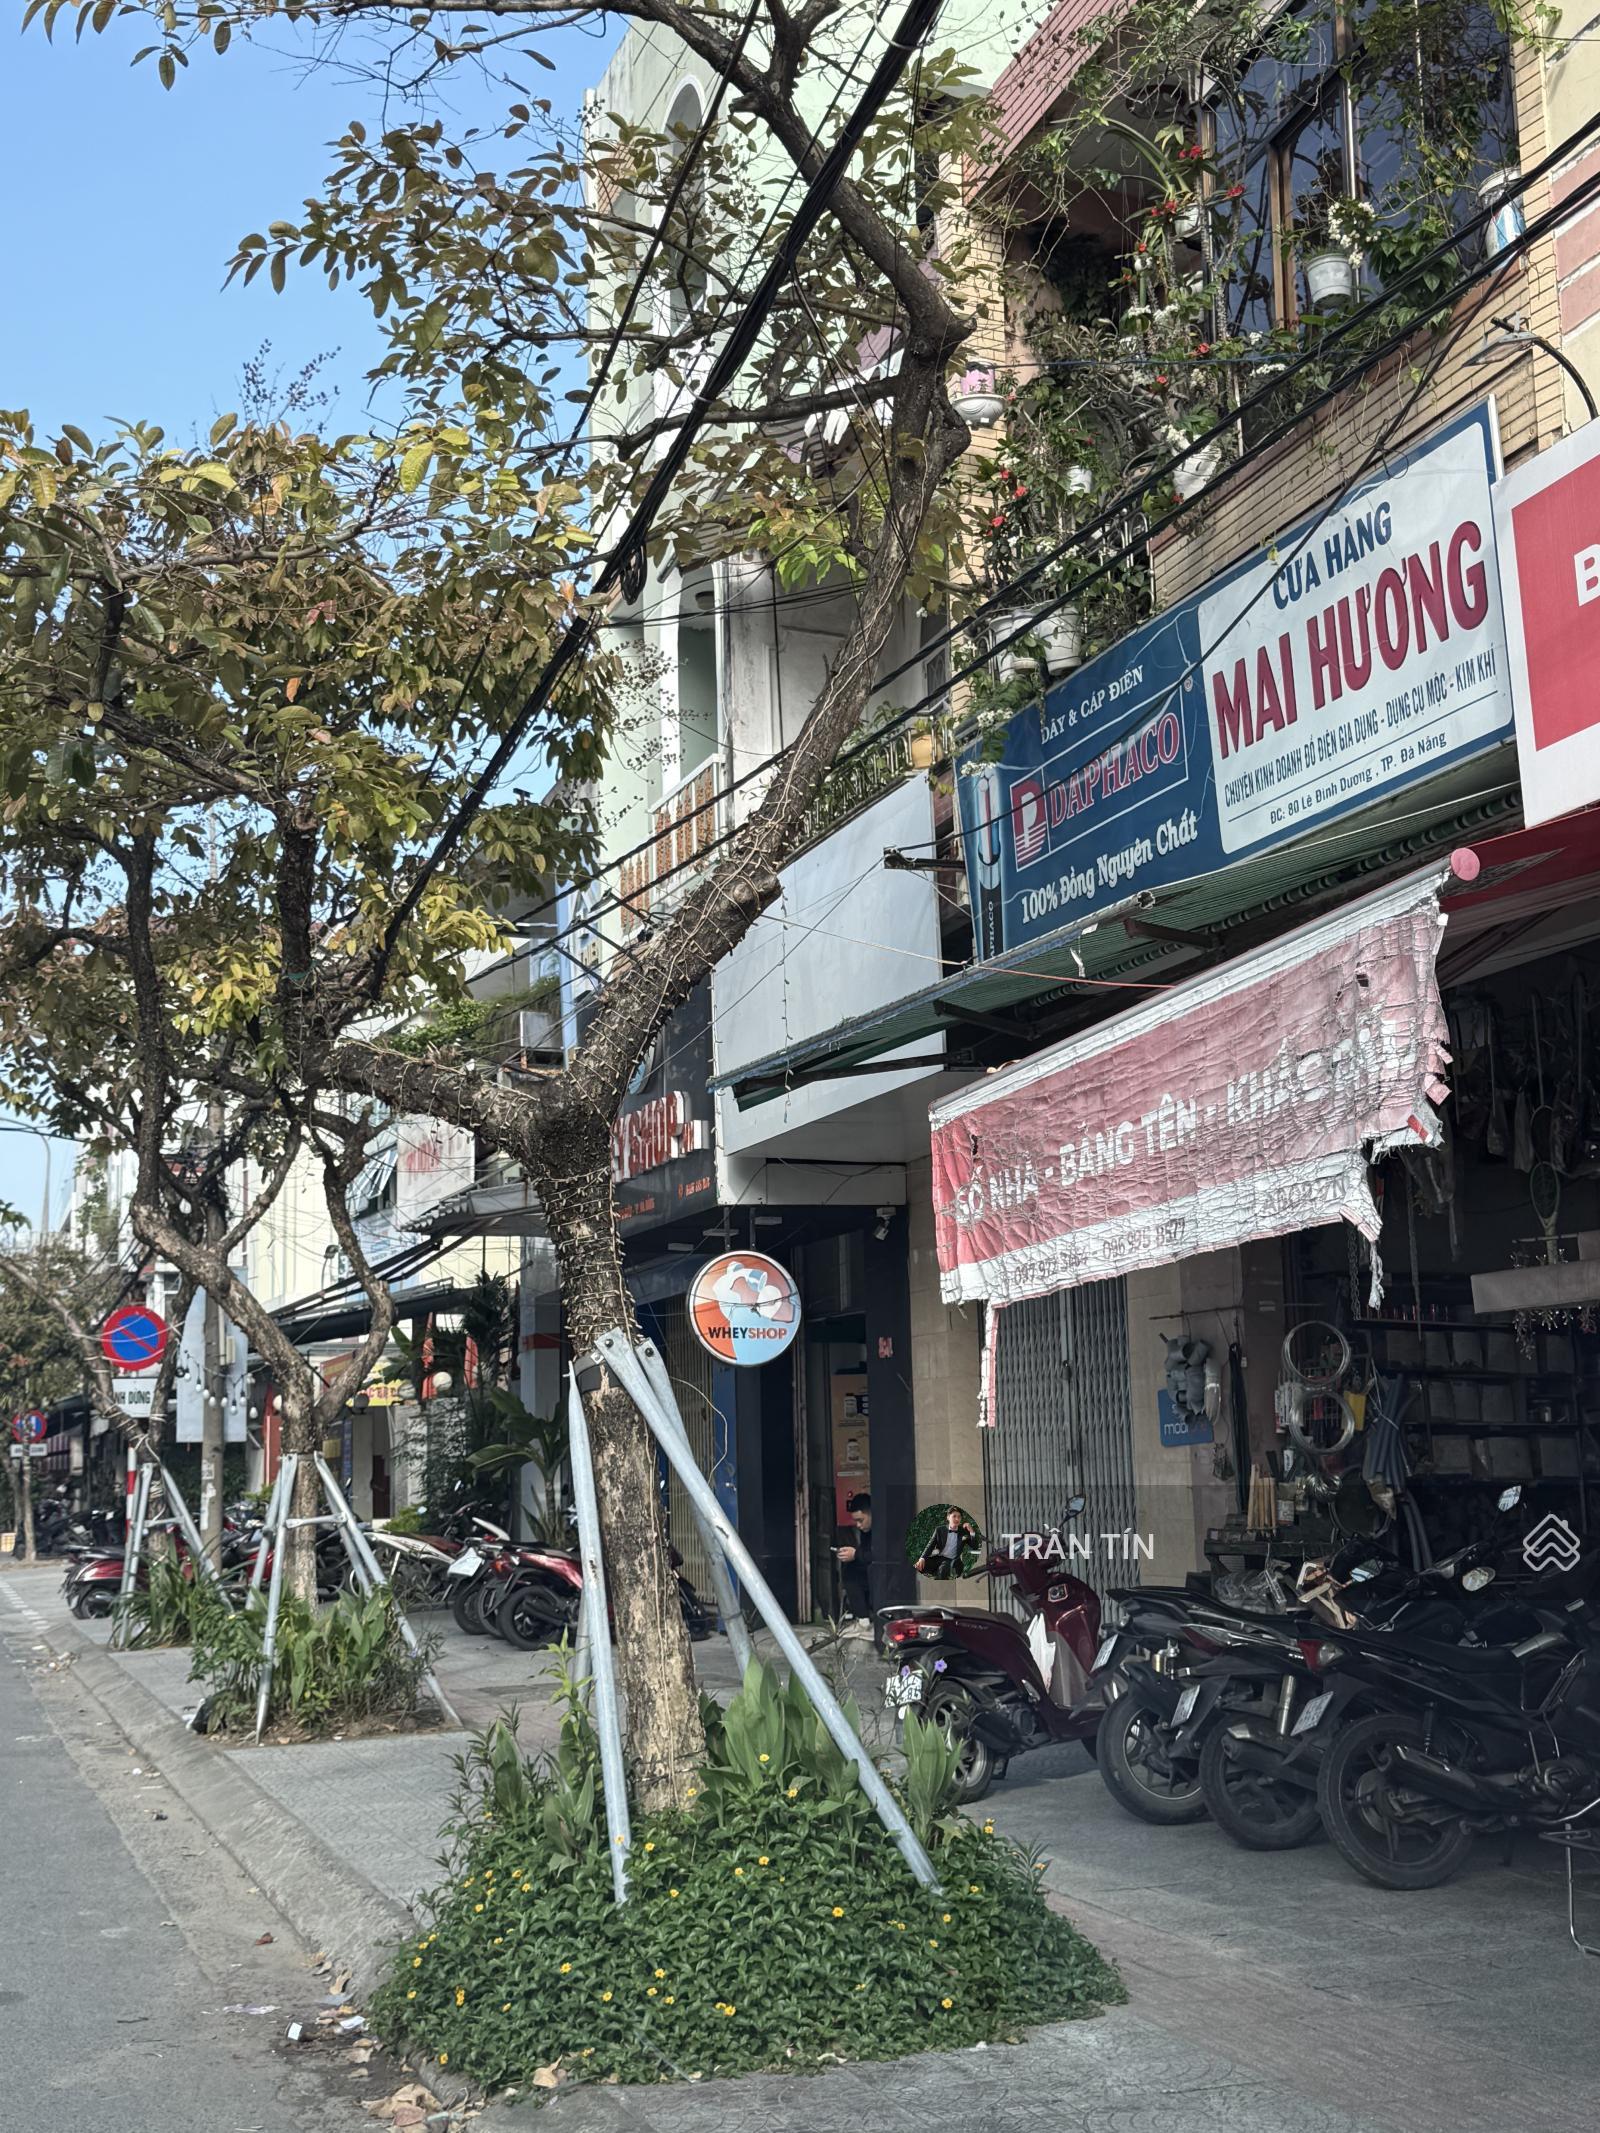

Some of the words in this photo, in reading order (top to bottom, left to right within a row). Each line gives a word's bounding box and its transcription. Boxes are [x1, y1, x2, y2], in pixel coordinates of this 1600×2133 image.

[1323, 501, 1392, 579] HÀNG
[1212, 631, 1298, 760] MAI
[1306, 520, 1489, 711] HƯƠNG
[1040, 714, 1066, 745] DÂY
[1068, 708, 1078, 727] &
[1108, 664, 1144, 702] ĐIỆN
[1224, 770, 1255, 807] CHUYÊN
[1255, 761, 1275, 792] KINH
[1276, 747, 1303, 783] DOANH
[1338, 721, 1354, 752] GIA
[1354, 708, 1379, 745] DỤNG
[1386, 692, 1412, 729] DỤNG
[1412, 682, 1425, 716] CỤ
[1426, 671, 1448, 708] MỘC
[1455, 658, 1476, 693] KIM
[1477, 642, 1497, 682] KHÍ
[1049, 711, 1181, 830] DAPHACO
[1288, 800, 1300, 817] 80
[1021, 881, 1058, 924] 100%
[1059, 866, 1095, 905] Đồng
[1096, 837, 1154, 888] Nguyên
[1156, 807, 1198, 856] Chất
[1059, 1120, 1135, 1187] BẢNG
[1140, 1092, 1198, 1157] TÊN
[707, 1326, 788, 1340] WHEYSHOP
